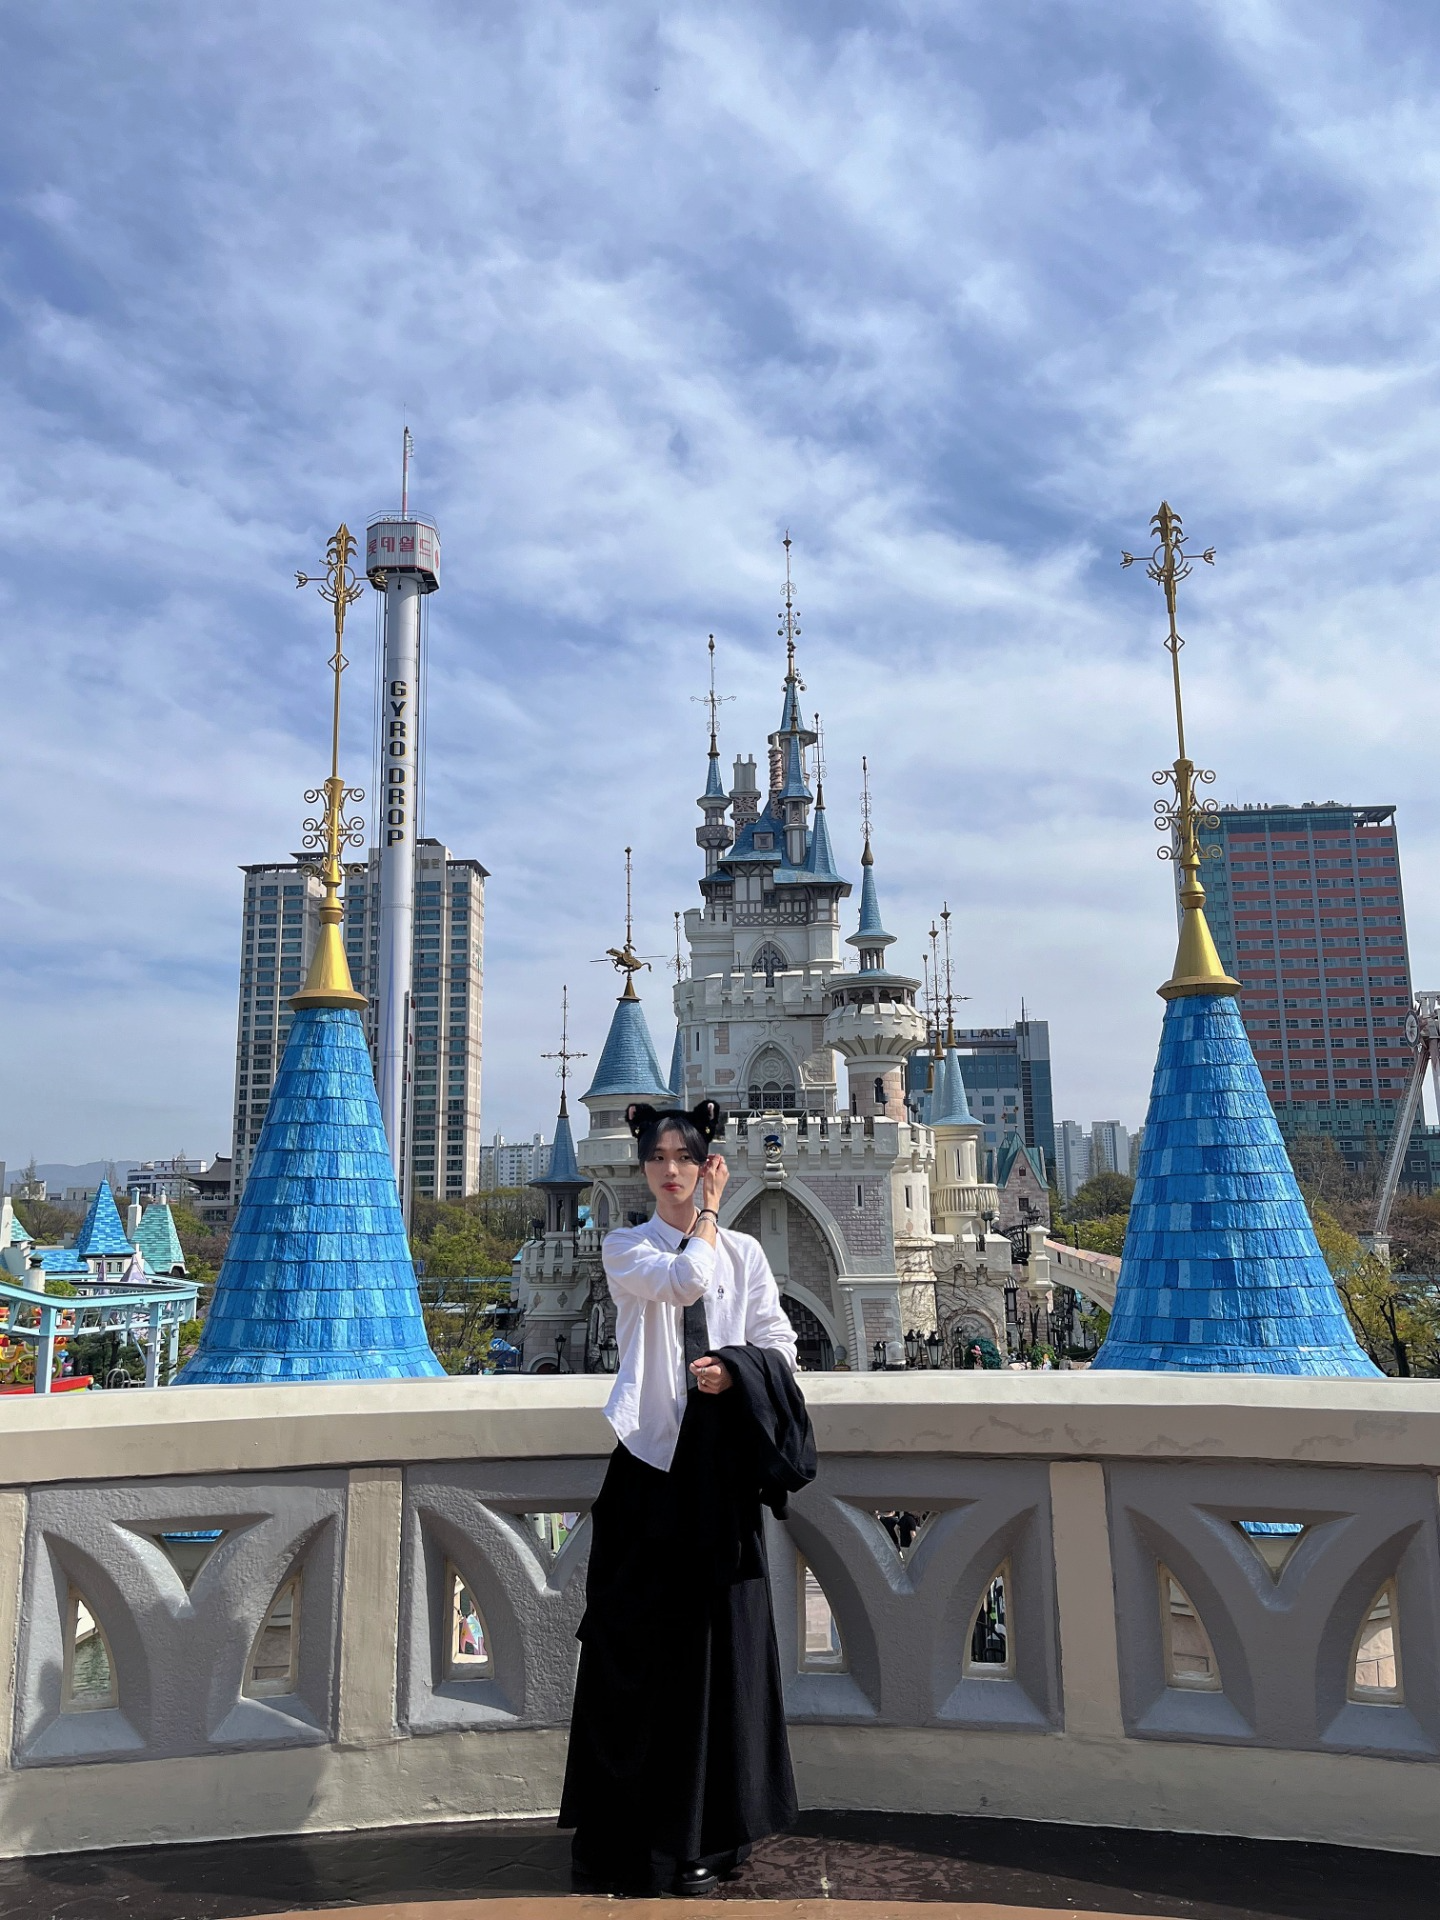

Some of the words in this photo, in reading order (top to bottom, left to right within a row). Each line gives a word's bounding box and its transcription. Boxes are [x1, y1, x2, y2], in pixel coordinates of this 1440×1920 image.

[368, 536, 431, 557] 롯데월드
[389, 680, 407, 757] GYRO
[387, 767, 406, 847] DROP
[970, 1028, 1011, 1038] LAKE
[966, 1064, 1016, 1074] ARDEN
